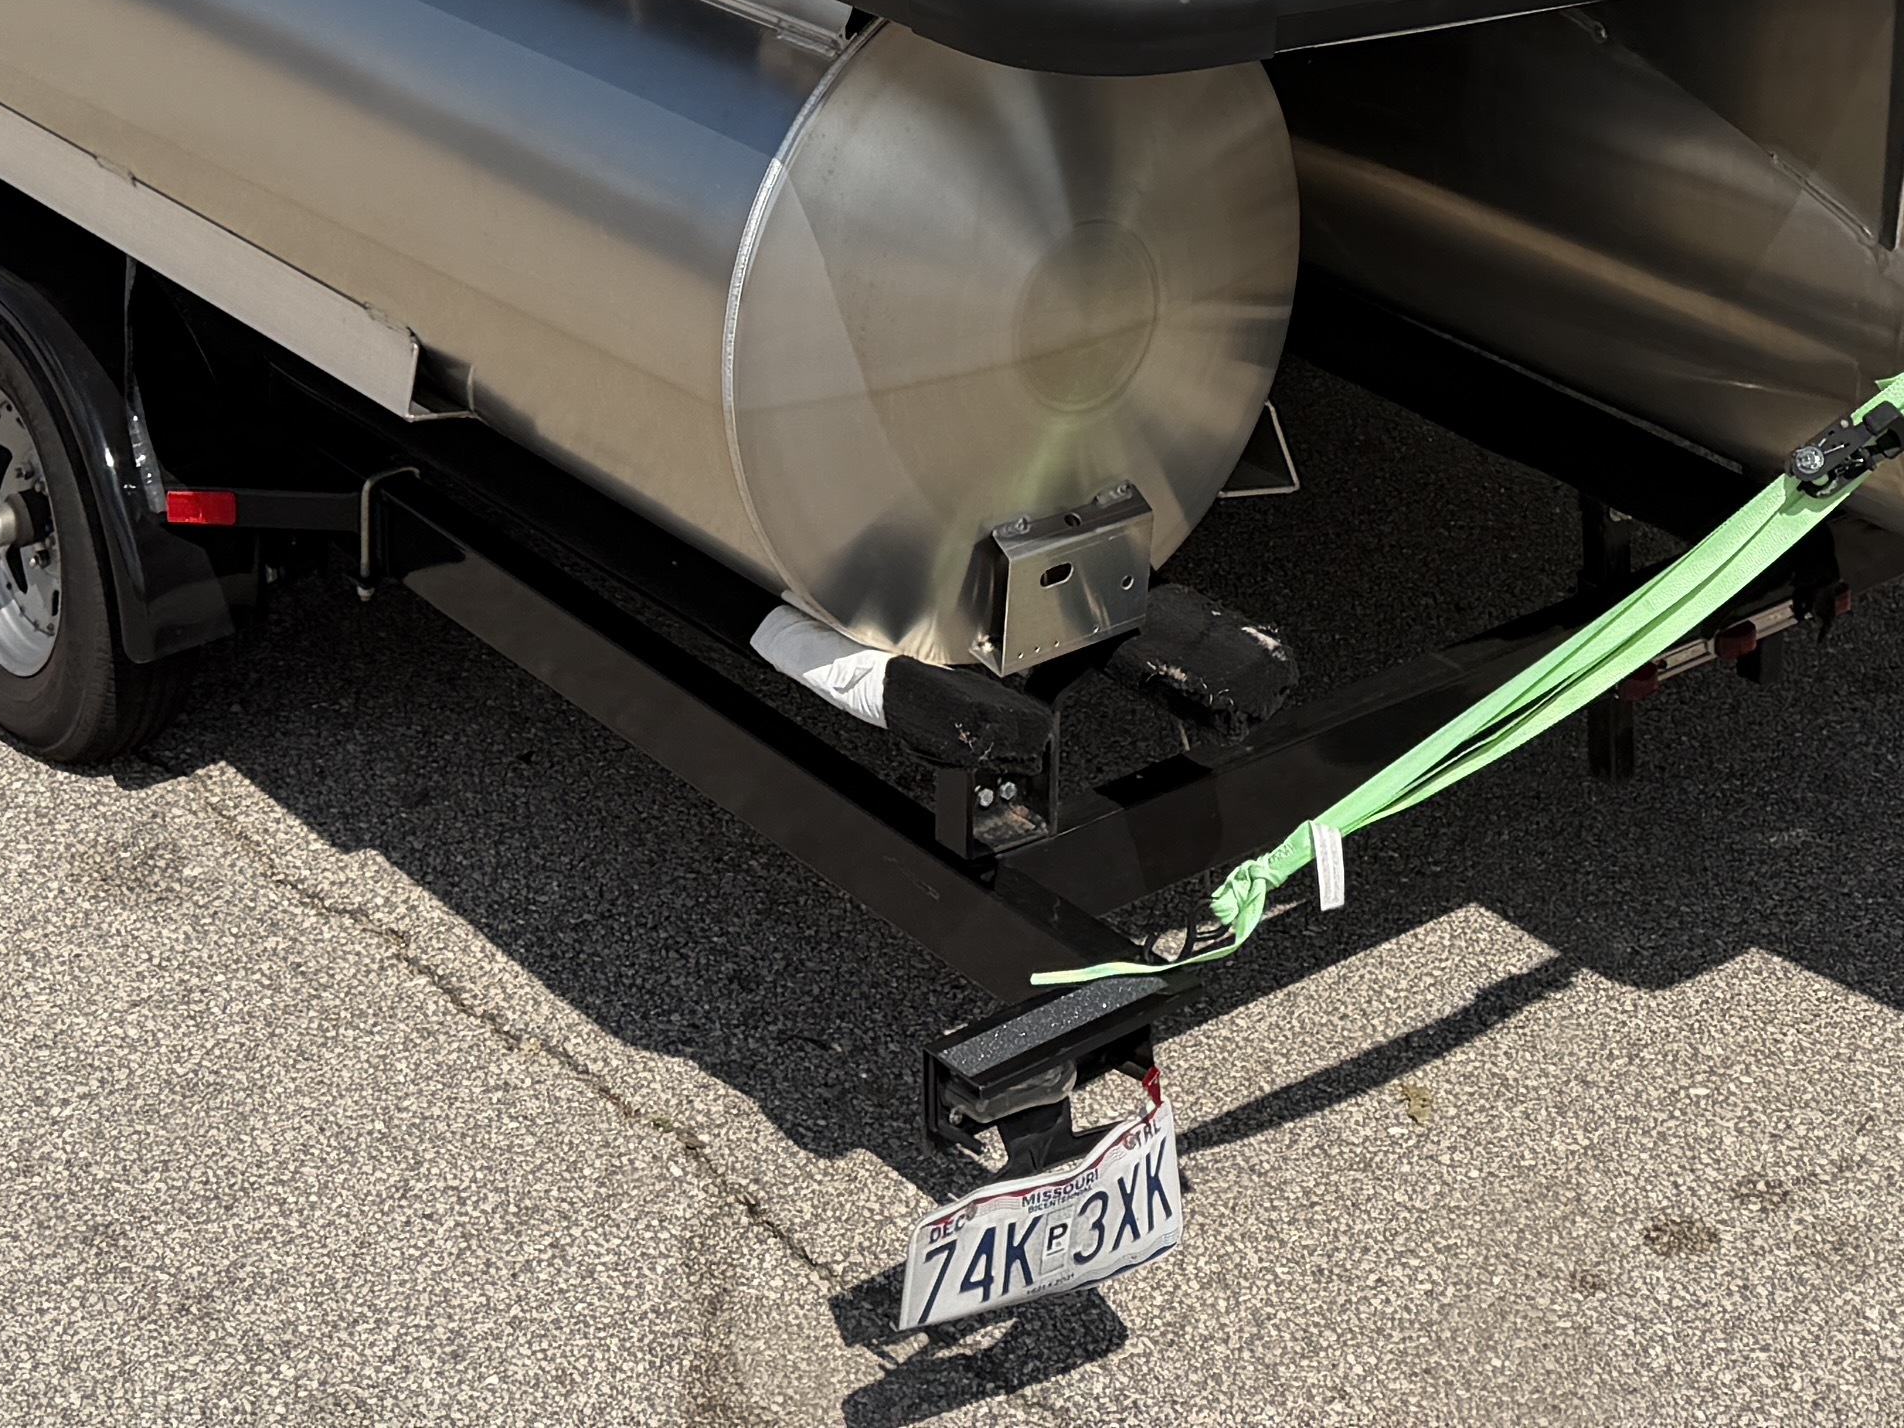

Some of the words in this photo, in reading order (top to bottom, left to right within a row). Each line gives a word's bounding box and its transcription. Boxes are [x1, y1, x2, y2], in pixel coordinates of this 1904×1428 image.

[1021, 1168, 1099, 1207] MISSOURI
[917, 1214, 1044, 1325] 74K
[1073, 1136, 1173, 1266] 3XK
[928, 1213, 966, 1245] DEC
